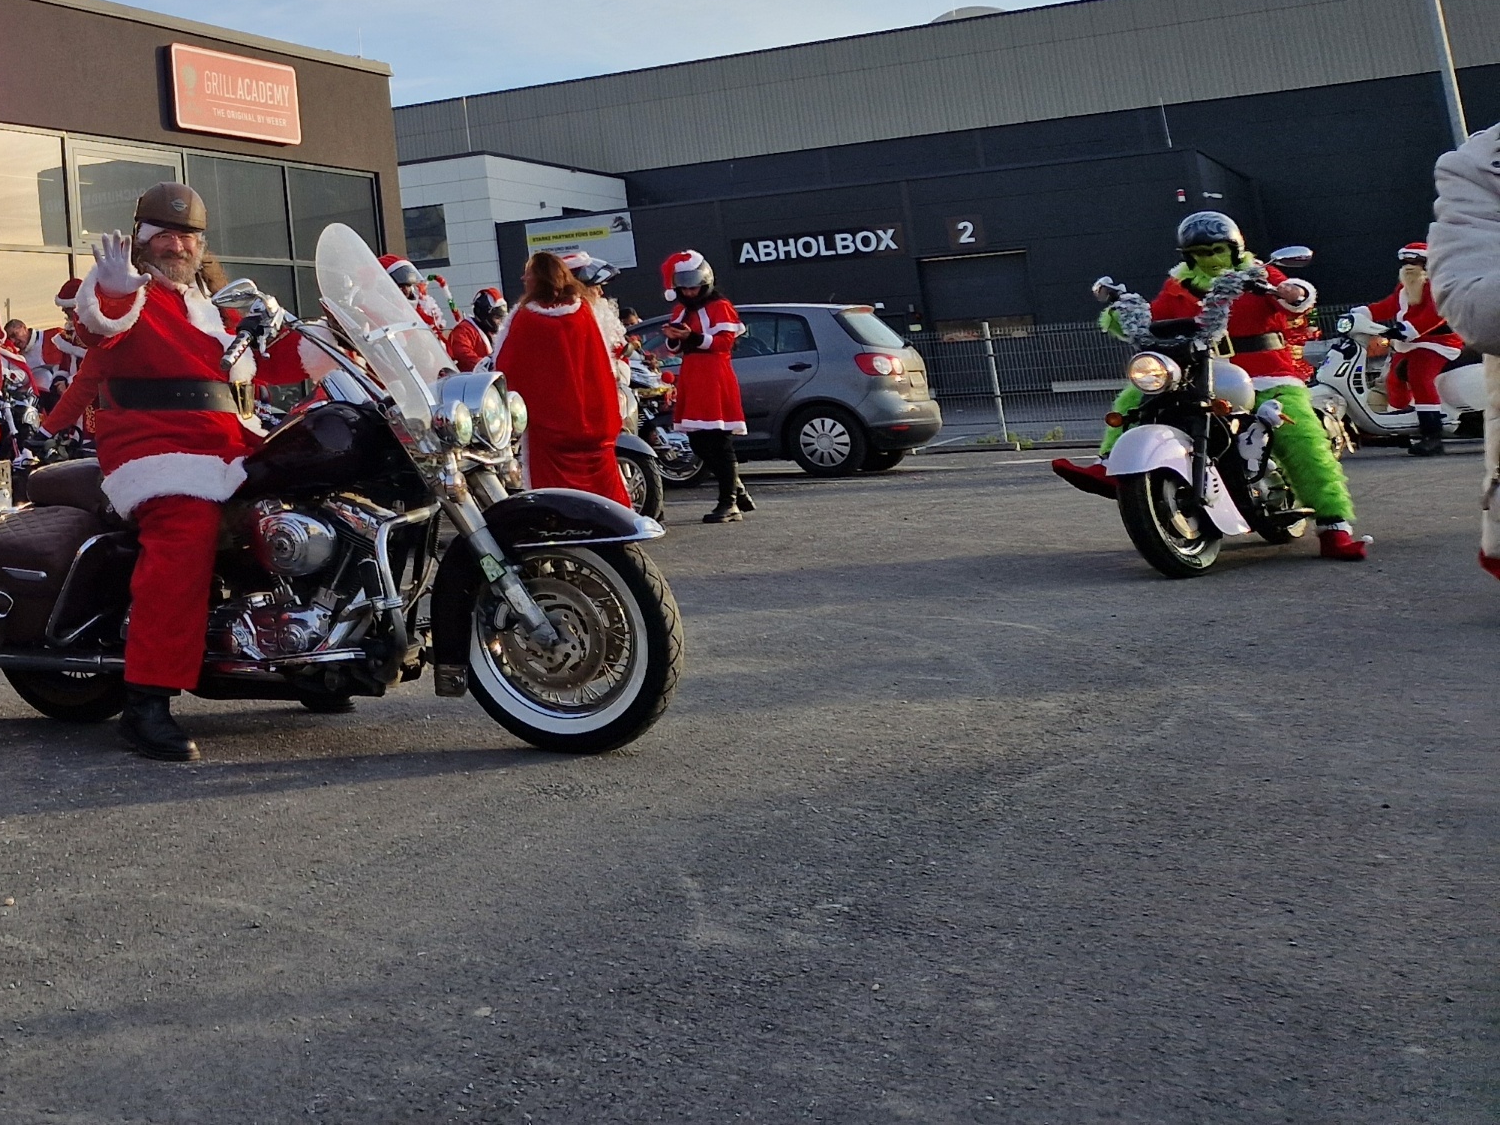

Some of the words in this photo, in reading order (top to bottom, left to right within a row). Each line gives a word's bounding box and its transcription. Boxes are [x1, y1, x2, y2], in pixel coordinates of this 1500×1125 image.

[204, 70, 235, 99] GRILL
[237, 76, 290, 107] ACADEMY
[212, 107, 225, 118] THE
[226, 110, 256, 123] ORIGINAL
[266, 115, 288, 127] WEBER
[739, 228, 899, 263] ABHOLBOX
[957, 221, 976, 244] 2
